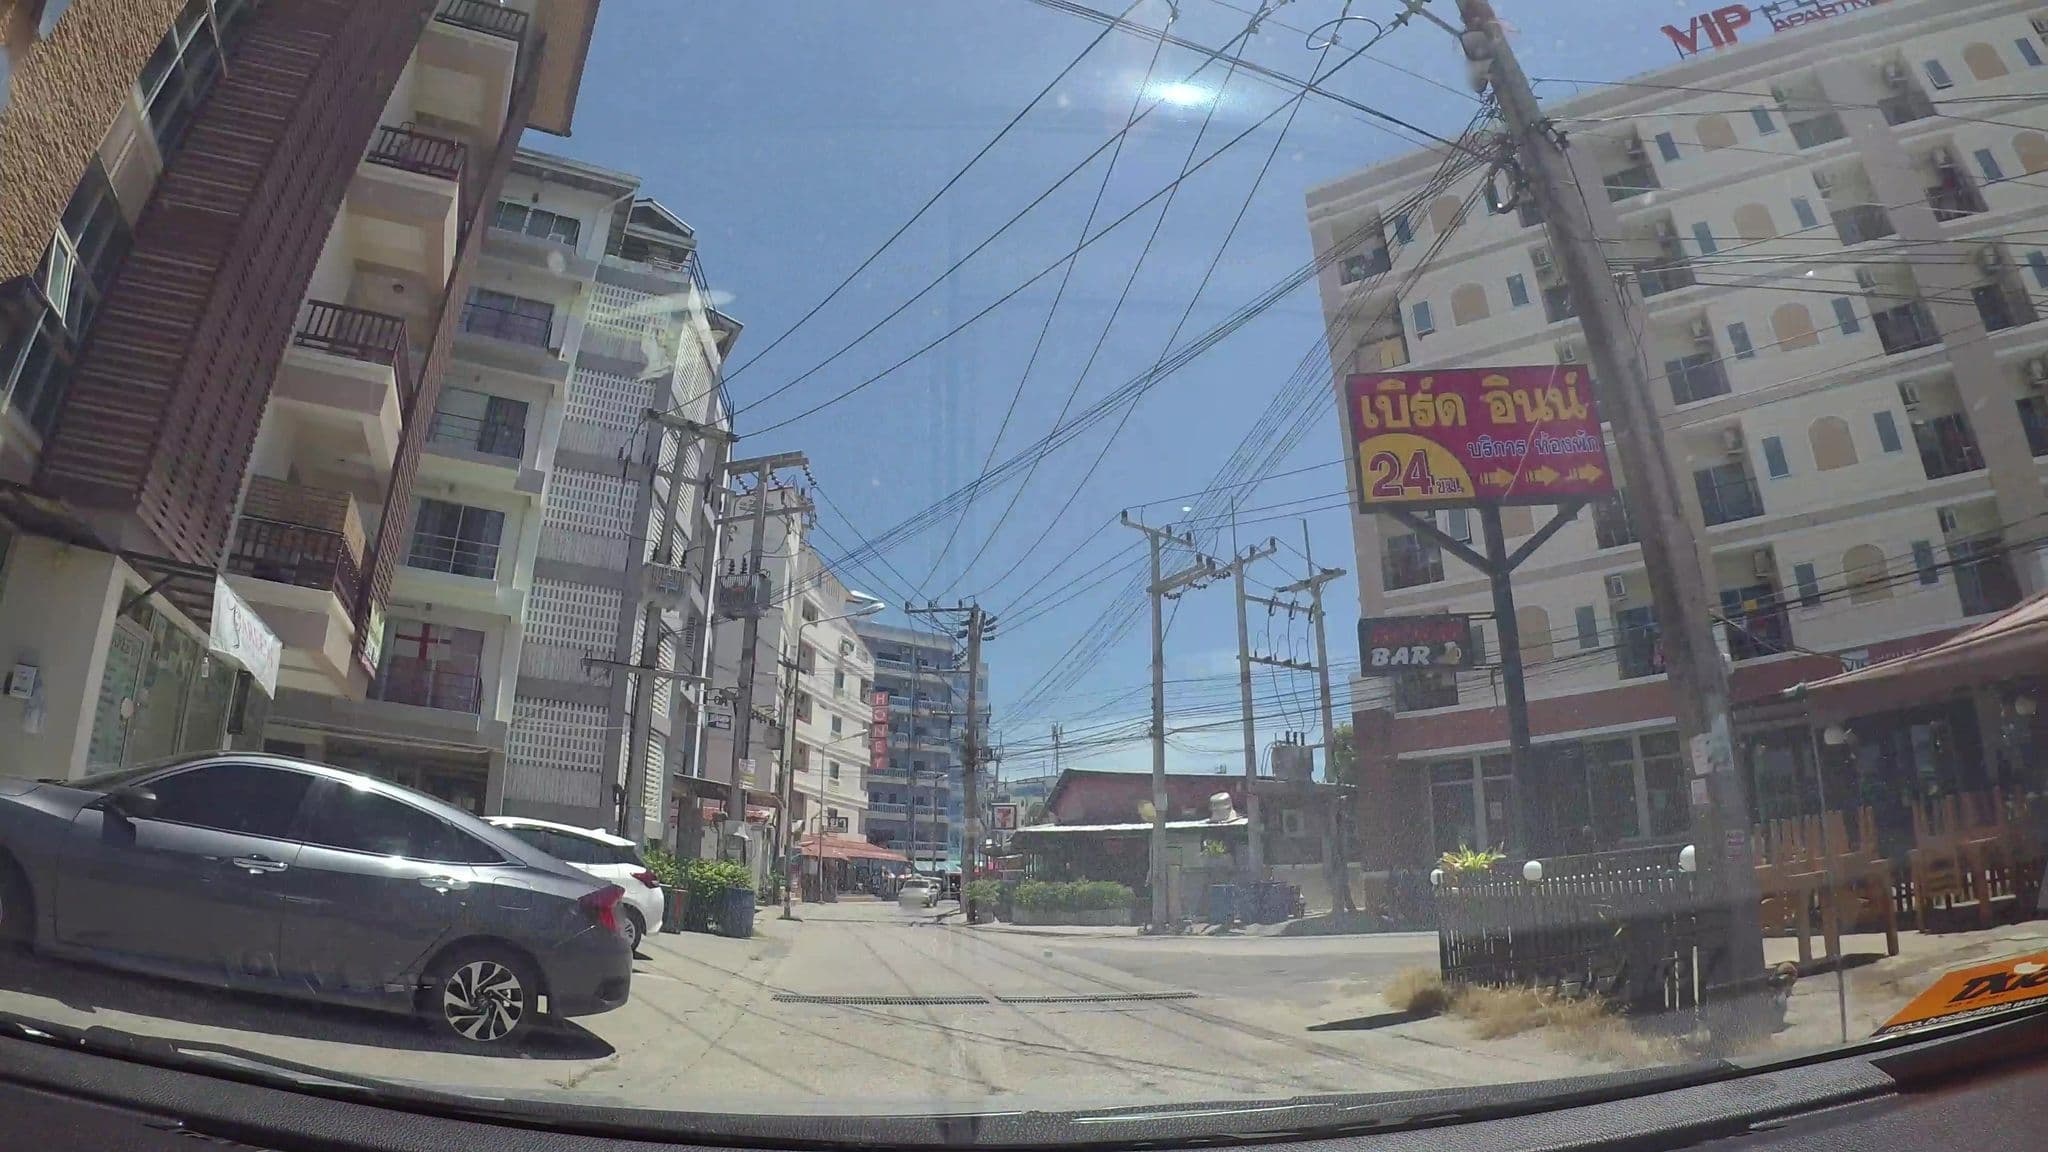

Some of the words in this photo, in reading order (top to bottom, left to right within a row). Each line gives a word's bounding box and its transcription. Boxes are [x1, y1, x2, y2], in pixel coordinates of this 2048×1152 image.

[1661, 4, 1751, 54] VIP
[1467, 434, 1527, 458] บริการ
[1369, 449, 1434, 498] 24
[1371, 646, 1430, 666] BAR
